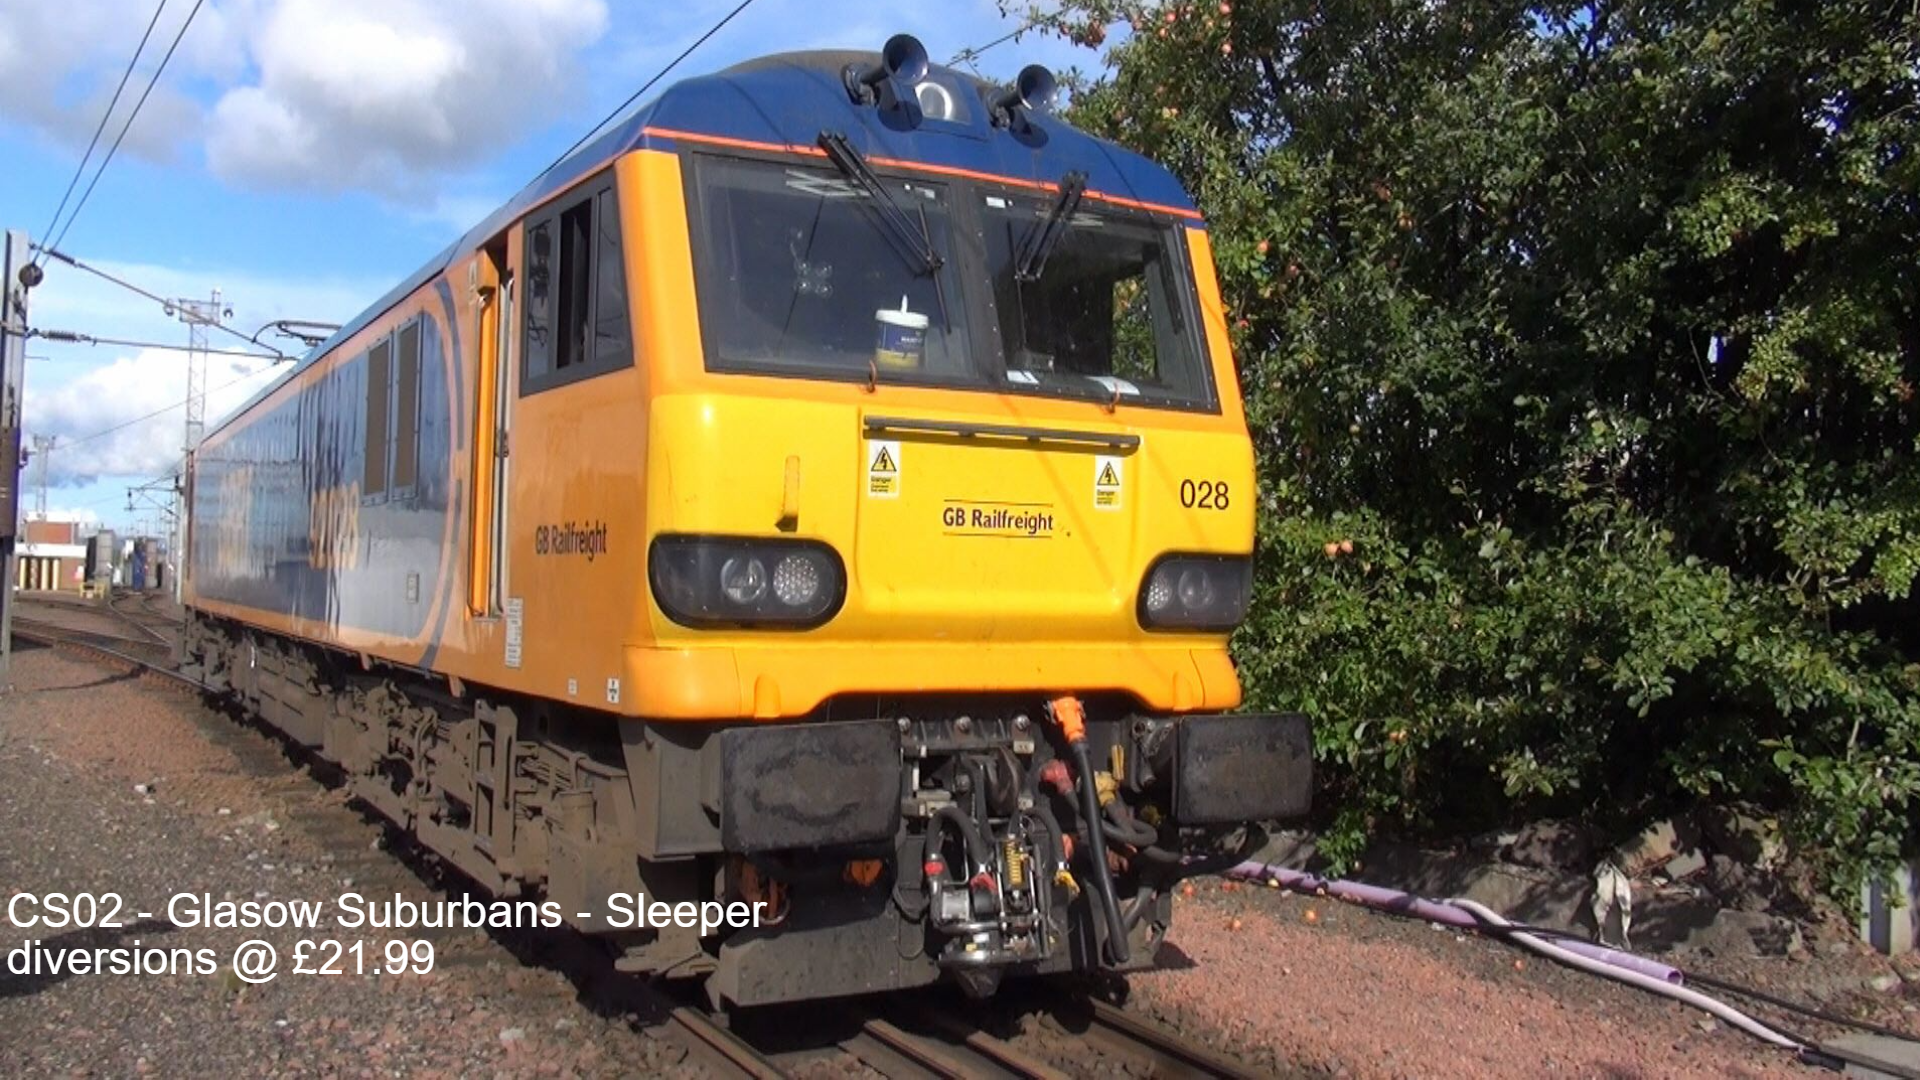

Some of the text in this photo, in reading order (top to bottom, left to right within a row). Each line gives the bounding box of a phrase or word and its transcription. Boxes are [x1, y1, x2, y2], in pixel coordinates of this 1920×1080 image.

[1180, 479, 1229, 510] 028
[943, 507, 1053, 535] GB Railfreight
[535, 519, 607, 563] GB Railfreight
